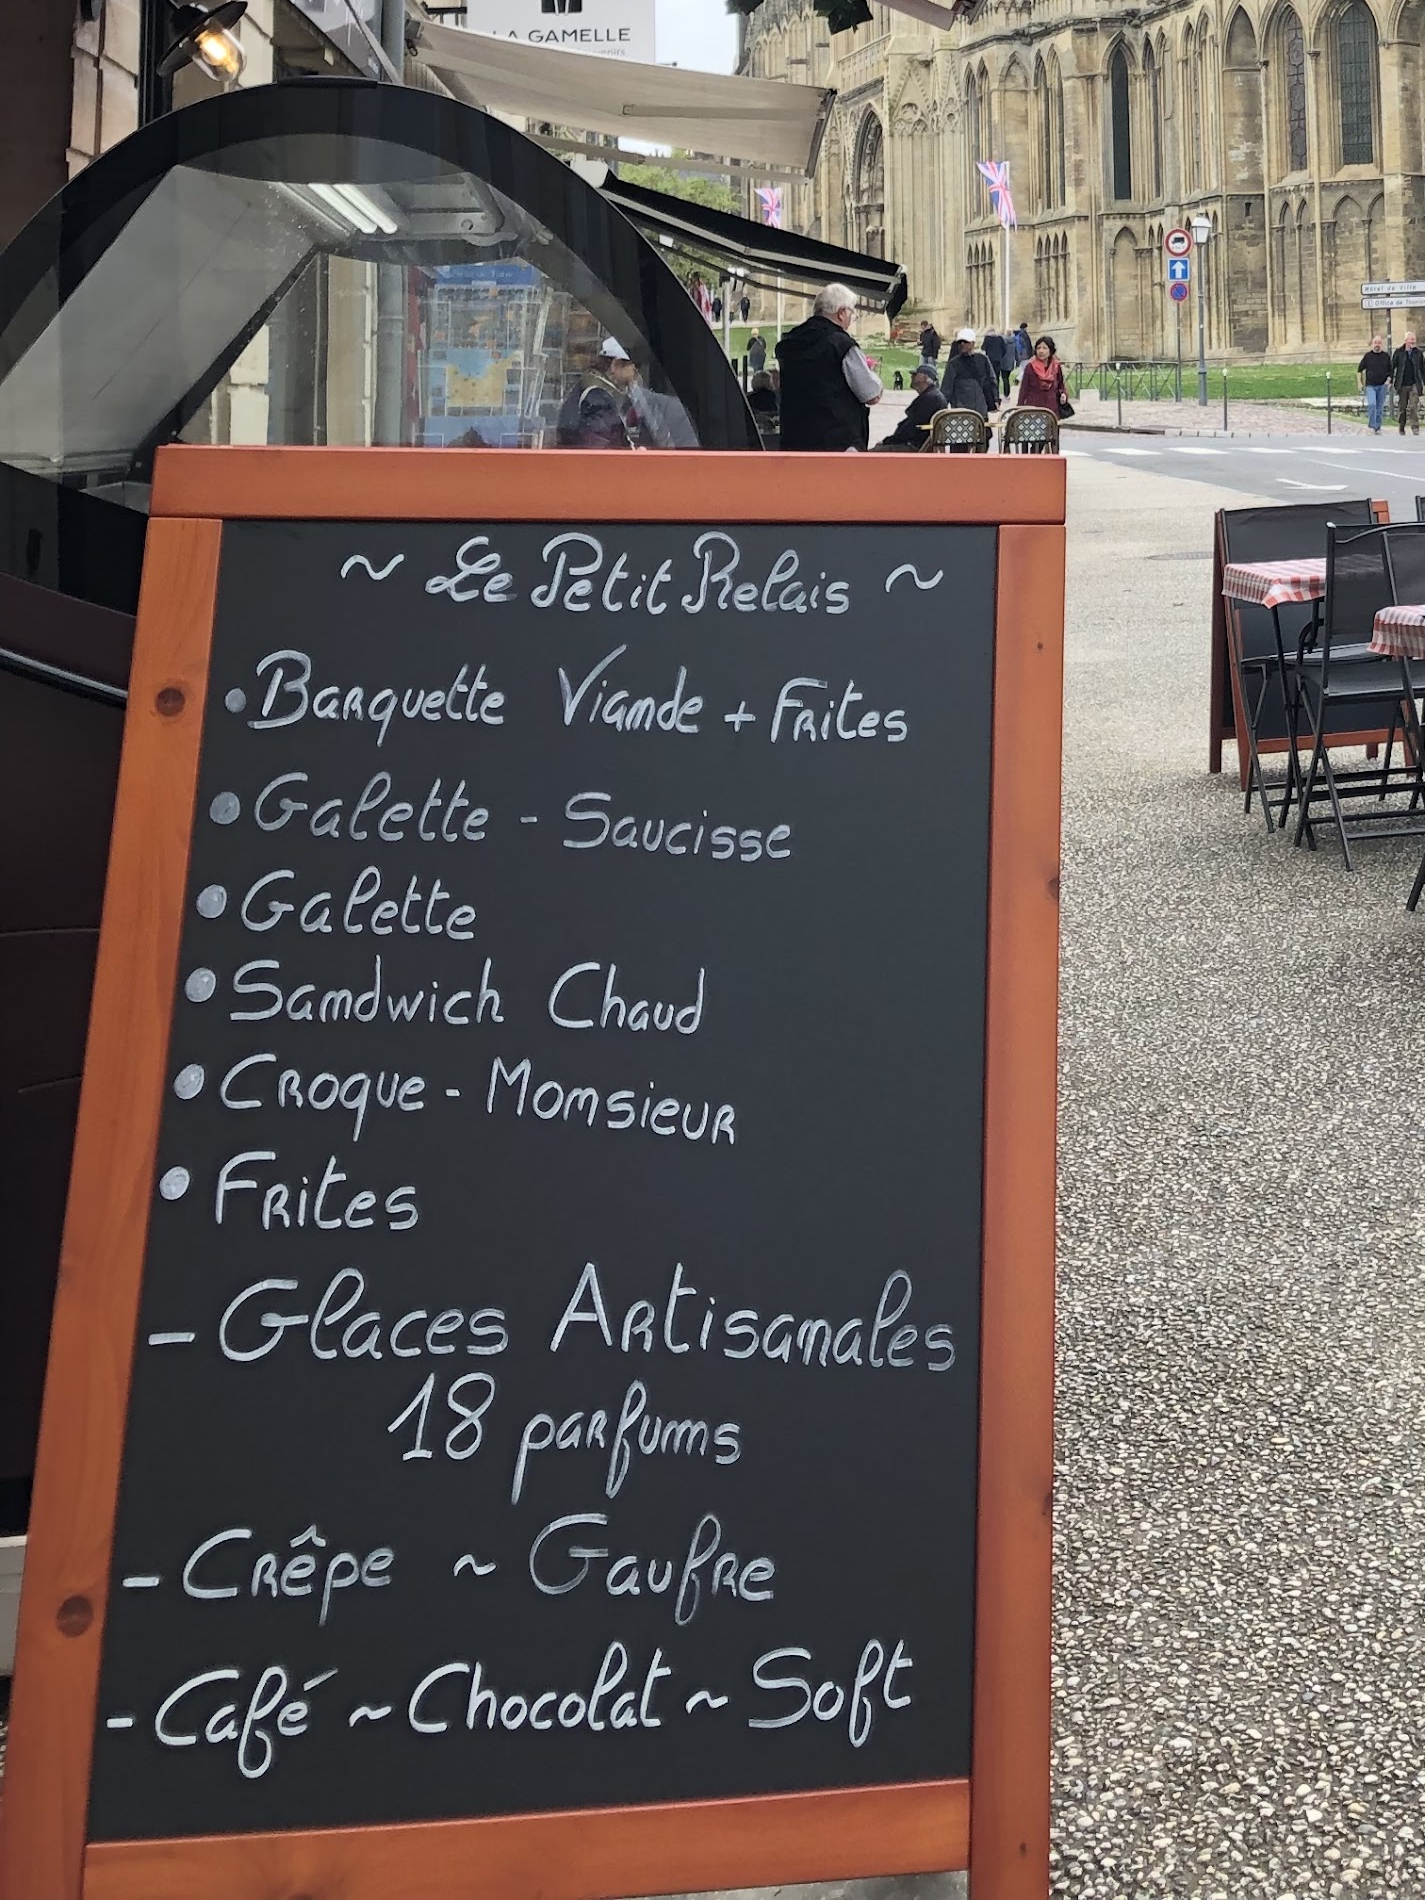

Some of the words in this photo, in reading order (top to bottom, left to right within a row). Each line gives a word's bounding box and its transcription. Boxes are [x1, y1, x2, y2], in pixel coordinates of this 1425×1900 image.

[528, 28, 631, 43] GAMELLE
[425, 536, 513, 603] Le
[531, 532, 673, 615] Petit
[680, 531, 850, 615] Relais
[558, 644, 704, 734] Viande
[254, 771, 489, 843] Galette
[563, 791, 791, 863] Saucisse
[240, 866, 477, 941] Galette
[229, 954, 505, 1024] Sandwich
[548, 961, 705, 1035] Chaud
[219, 1267, 509, 1362] Glaces
[387, 1372, 496, 1461] 18
[511, 1379, 741, 1504] parfums
[154, 1665, 339, 1779] Café
[408, 1641, 672, 1734] Chocolat
[748, 1638, 914, 1748] Soft
